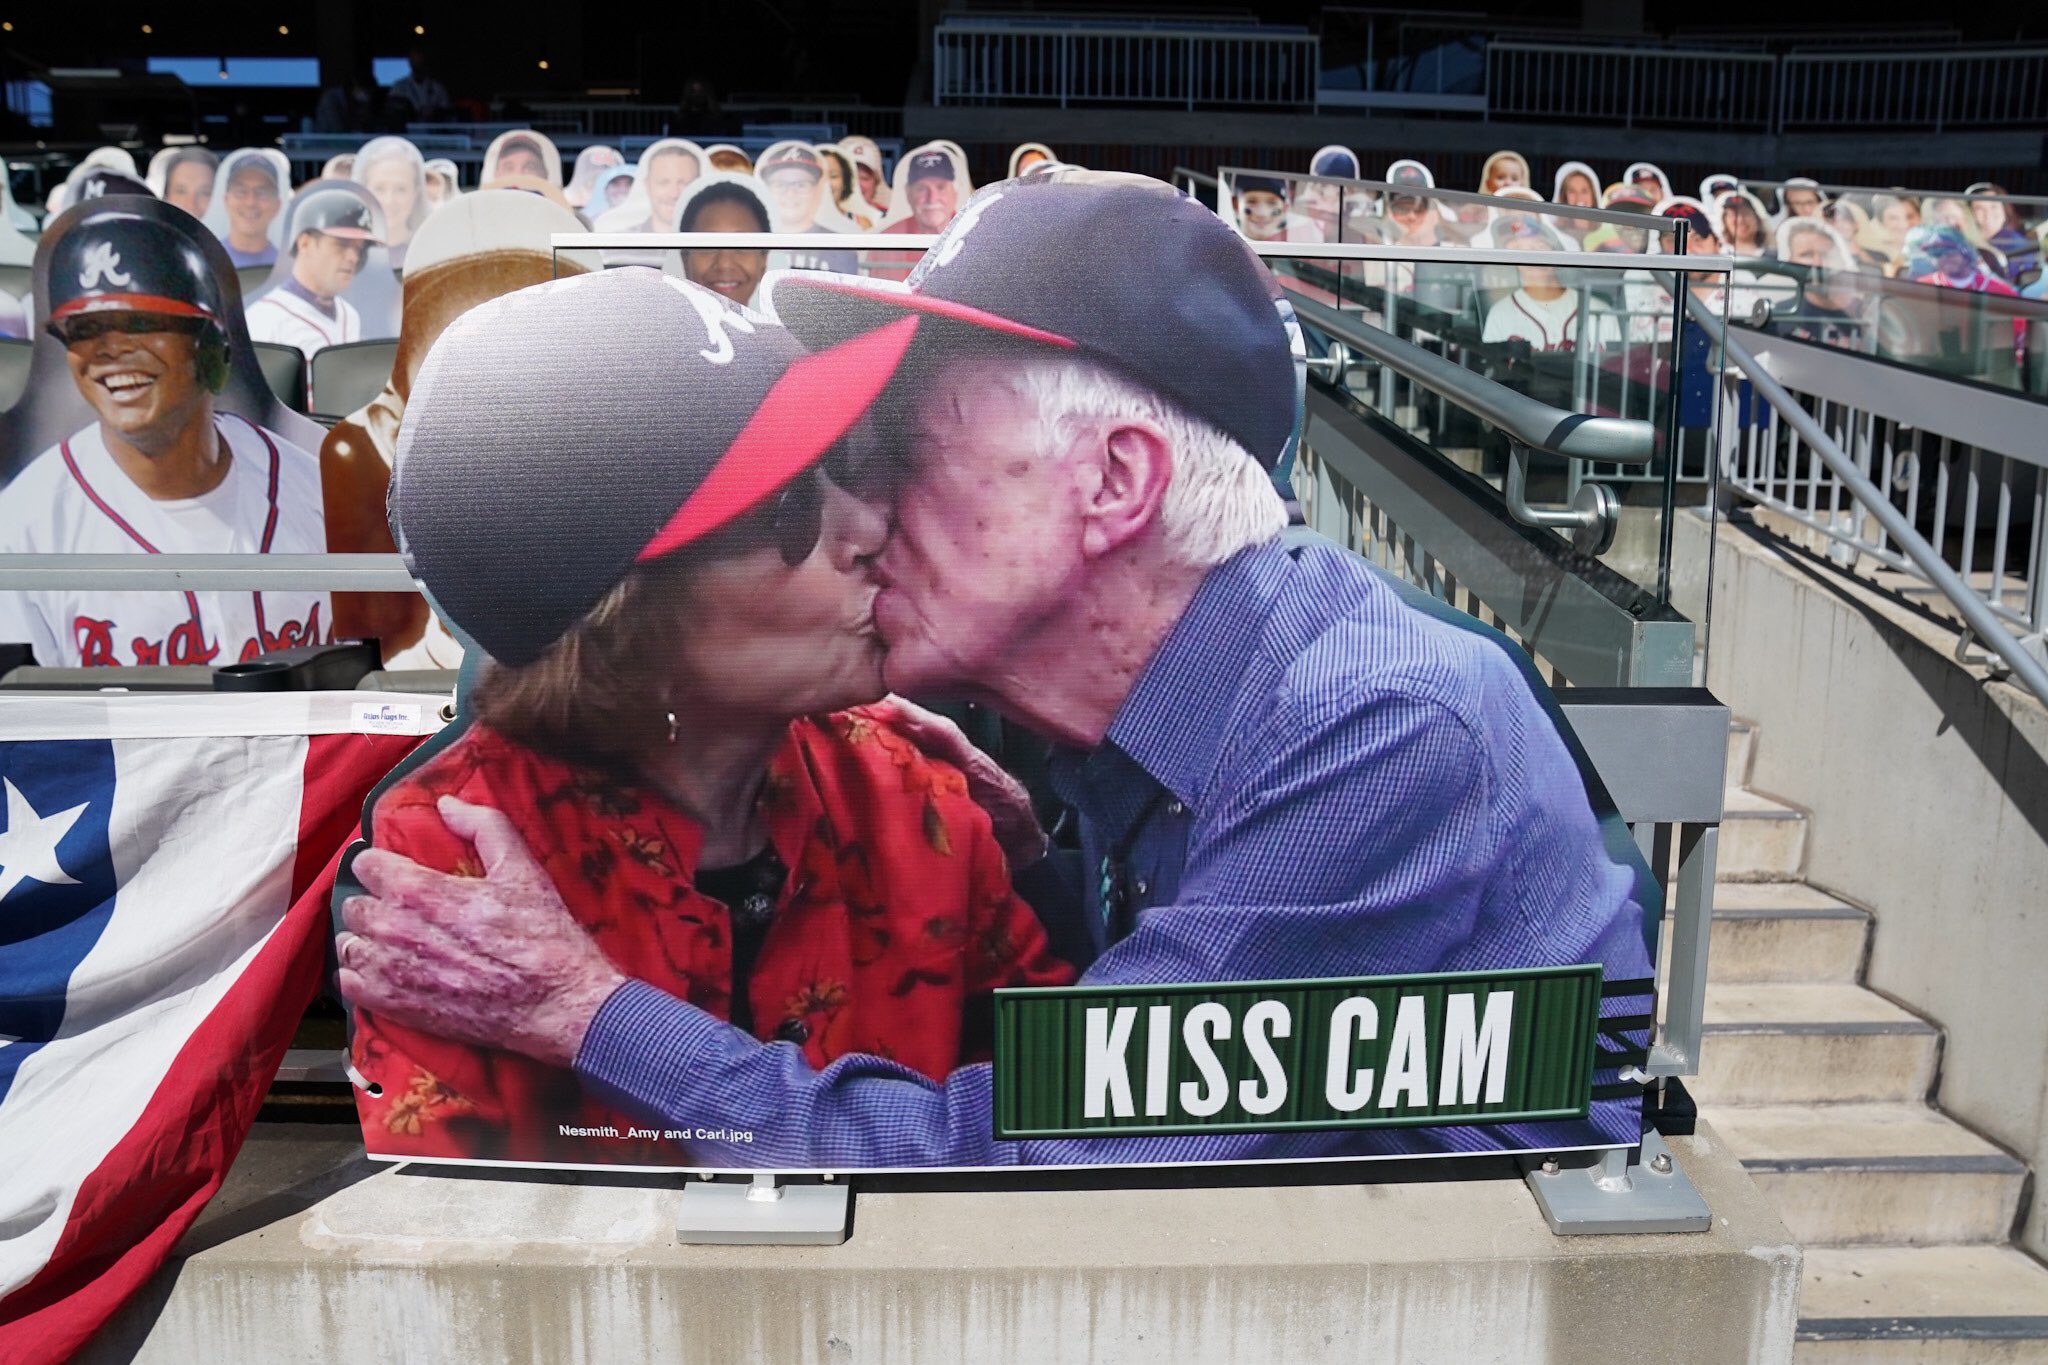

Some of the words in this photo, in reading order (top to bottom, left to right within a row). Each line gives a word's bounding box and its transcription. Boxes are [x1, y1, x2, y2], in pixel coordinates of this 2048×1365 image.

[1084, 999, 1292, 1118] KISS
[1325, 990, 1514, 1112] CAM
[559, 1124, 660, 1142] Nesmith_Amy
[664, 1127, 692, 1140] and
[695, 1128, 753, 1143] Carl.jpg
